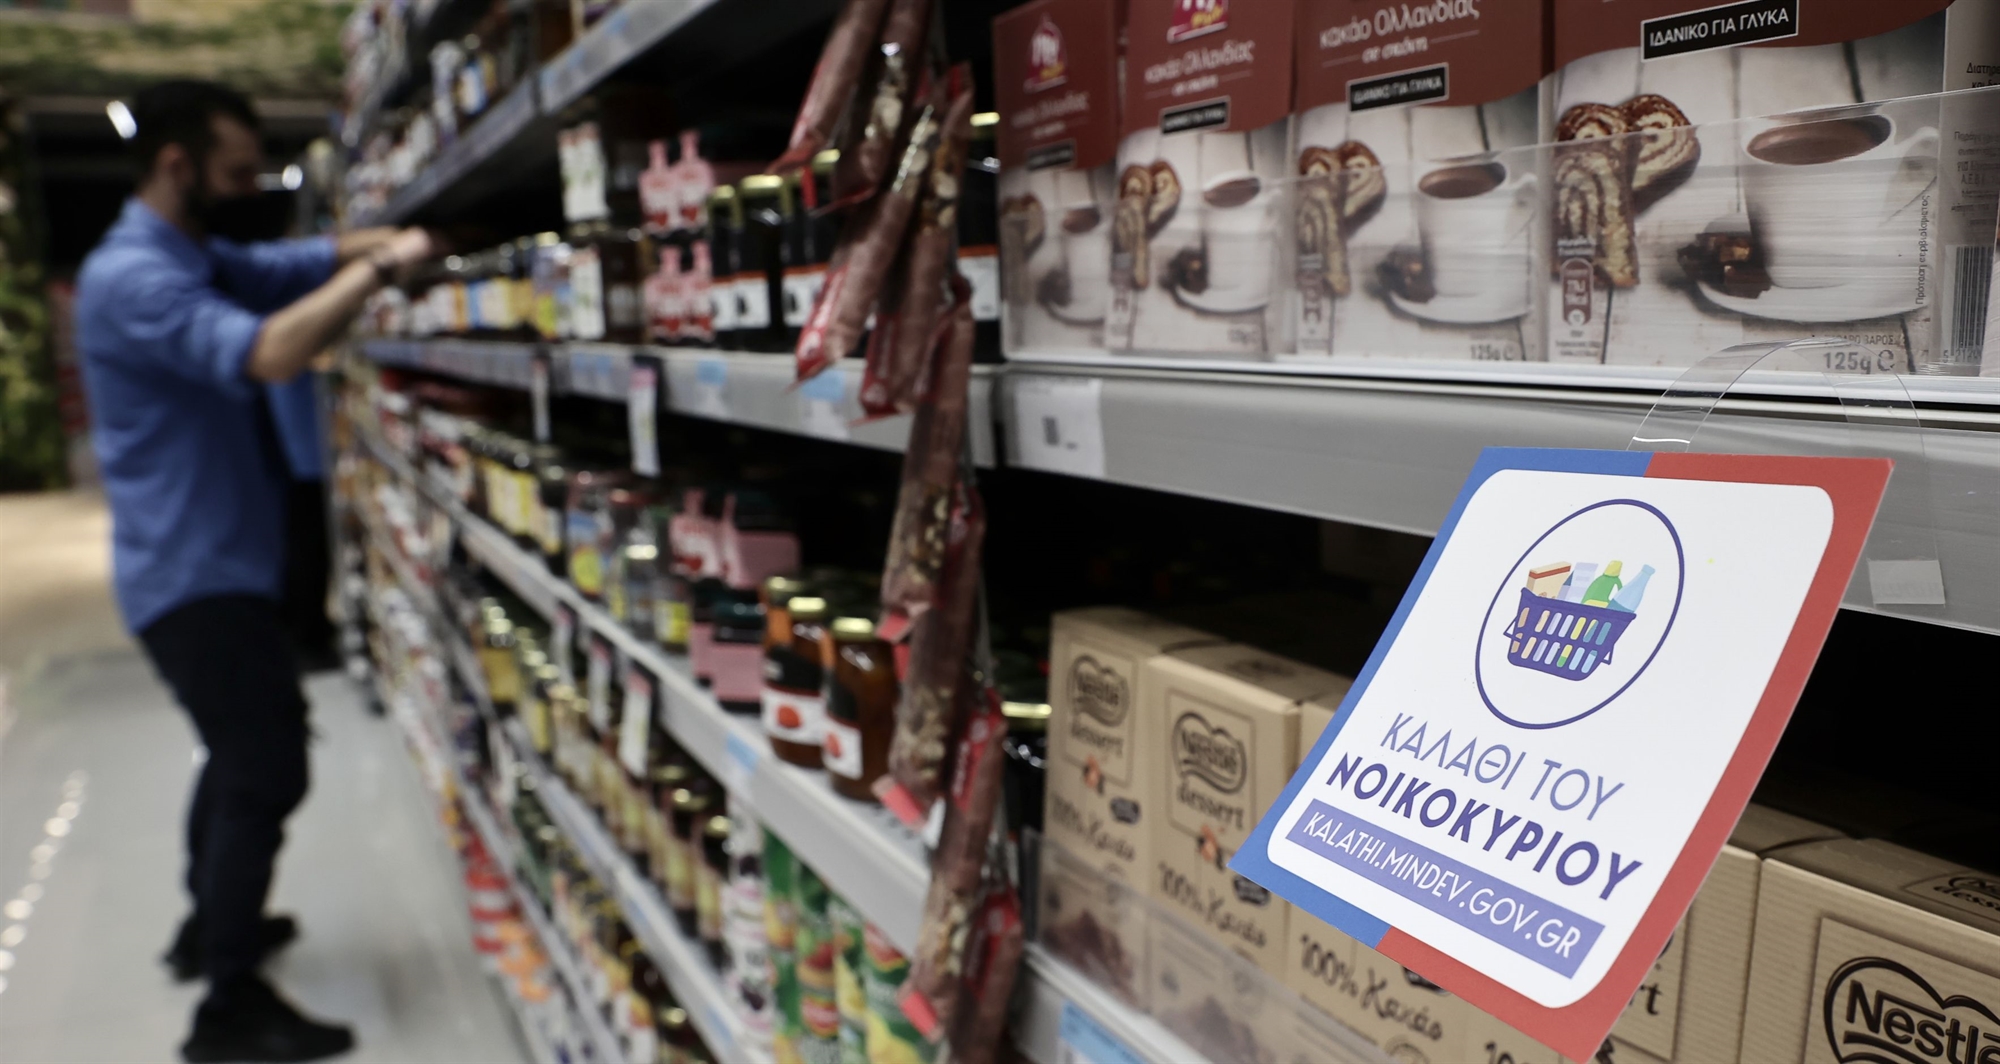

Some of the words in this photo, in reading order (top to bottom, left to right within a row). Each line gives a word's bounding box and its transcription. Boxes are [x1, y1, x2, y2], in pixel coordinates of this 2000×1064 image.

[1650, 22, 1708, 47] ΙΔΑΝΙΚΟ
[1711, 18, 1736, 35] ΓΙΑ
[1739, 8, 1789, 31] ΓΛΥΚΑ
[1915, 264, 1927, 304] Πρόταση
[1824, 352, 1872, 375] 125g
[1380, 712, 1527, 791] ΚΑΛΑΘΙ
[1530, 758, 1625, 822] ΤΟΥ
[1326, 752, 1643, 901] ΝΟΙΚΟΚΥΡΙΟΥ
[1303, 812, 1581, 958] KALATHI.MINDEV.GOV.GR
